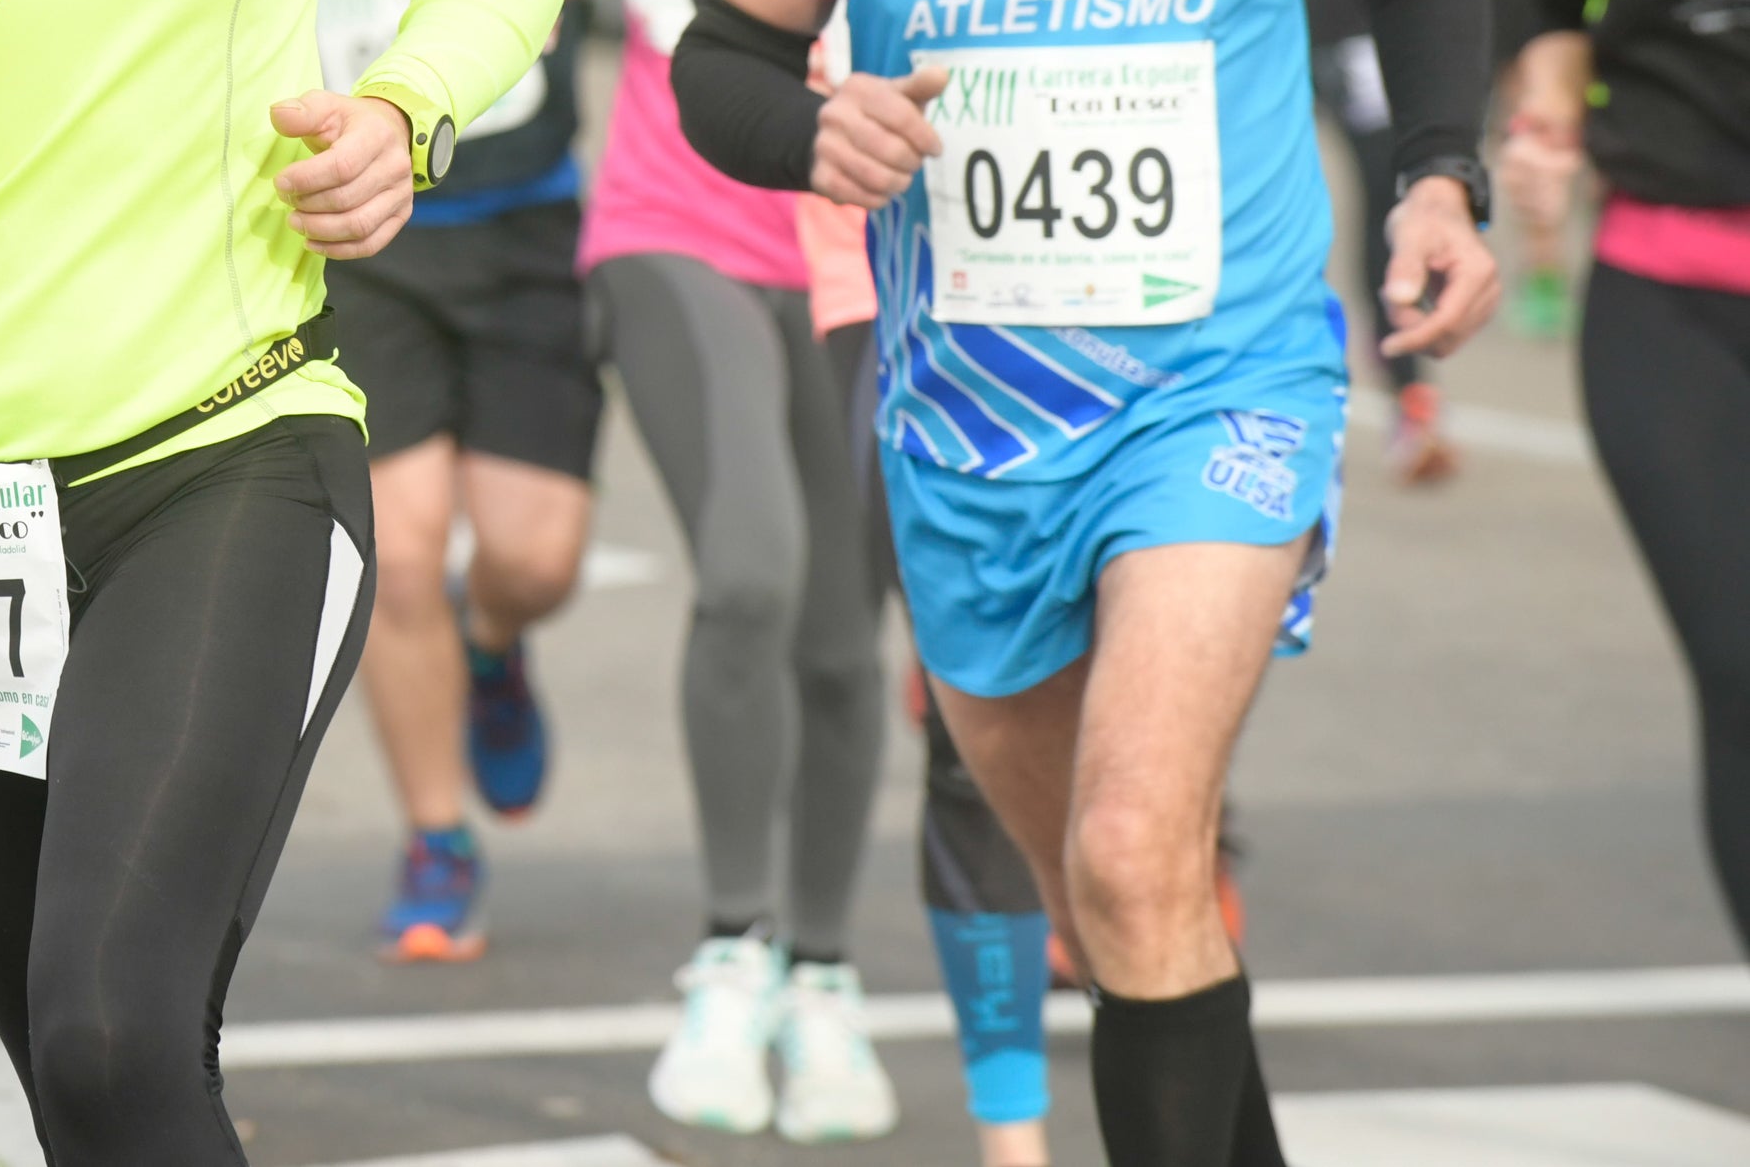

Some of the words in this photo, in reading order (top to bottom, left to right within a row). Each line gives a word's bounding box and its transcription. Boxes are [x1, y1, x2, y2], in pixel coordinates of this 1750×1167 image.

[964, 147, 1174, 239] 0439
[1207, 459, 1287, 518] ULSA
[22, 693, 33, 705] en
